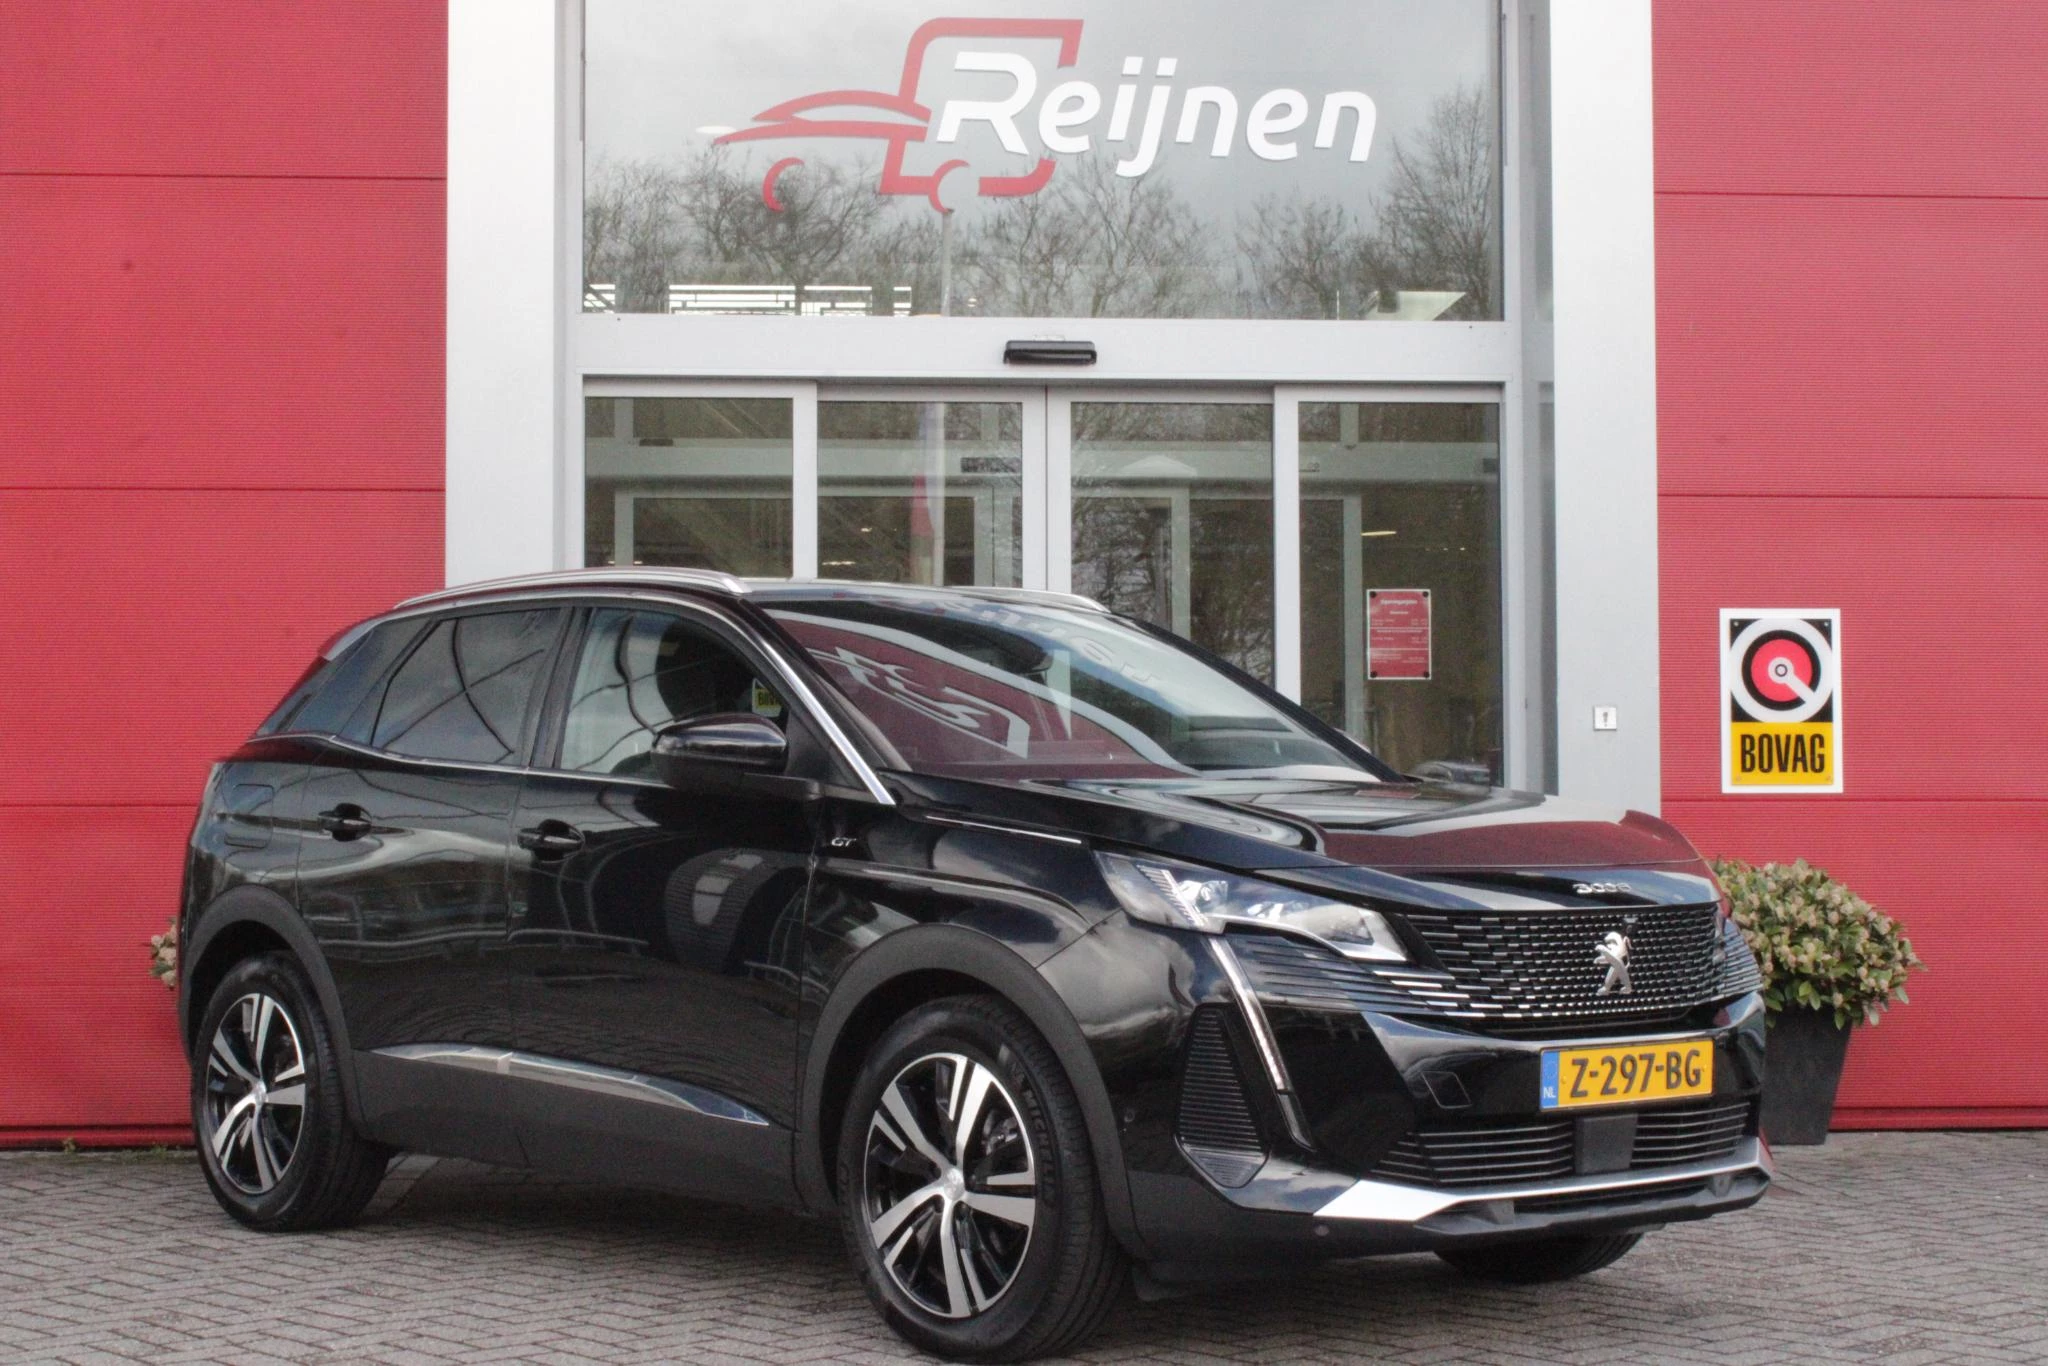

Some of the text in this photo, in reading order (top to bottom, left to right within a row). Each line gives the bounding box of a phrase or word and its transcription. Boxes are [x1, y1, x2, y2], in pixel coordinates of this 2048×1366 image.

[936, 51, 1377, 178] Reijnen
[1740, 733, 1825, 774] BOVAG
[831, 837, 857, 847] GT
[1543, 1086, 1557, 1099] NL
[1570, 1049, 1702, 1098] Z-297-BG
